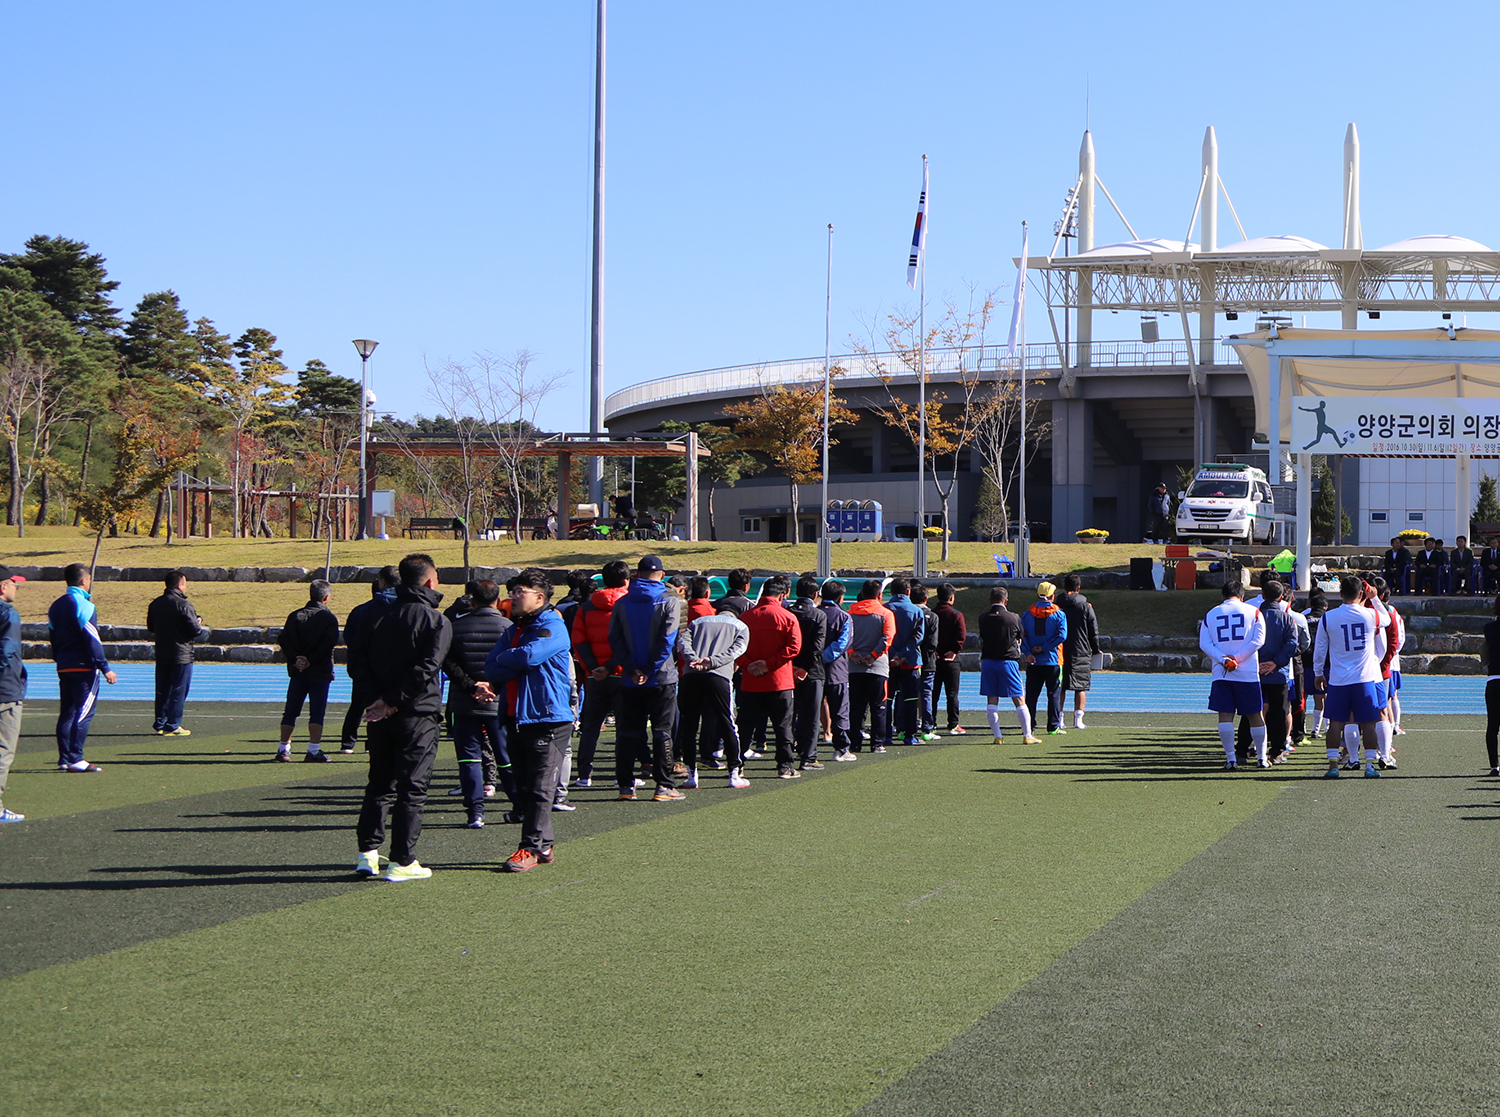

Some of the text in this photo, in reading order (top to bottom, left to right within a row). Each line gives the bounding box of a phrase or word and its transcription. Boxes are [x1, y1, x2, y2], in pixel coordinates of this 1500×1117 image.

[1357, 414, 1455, 439] 양양군의회
[1198, 472, 1248, 480] AMBULANCE
[1216, 613, 1245, 643] 22
[1340, 622, 1366, 652] 19
